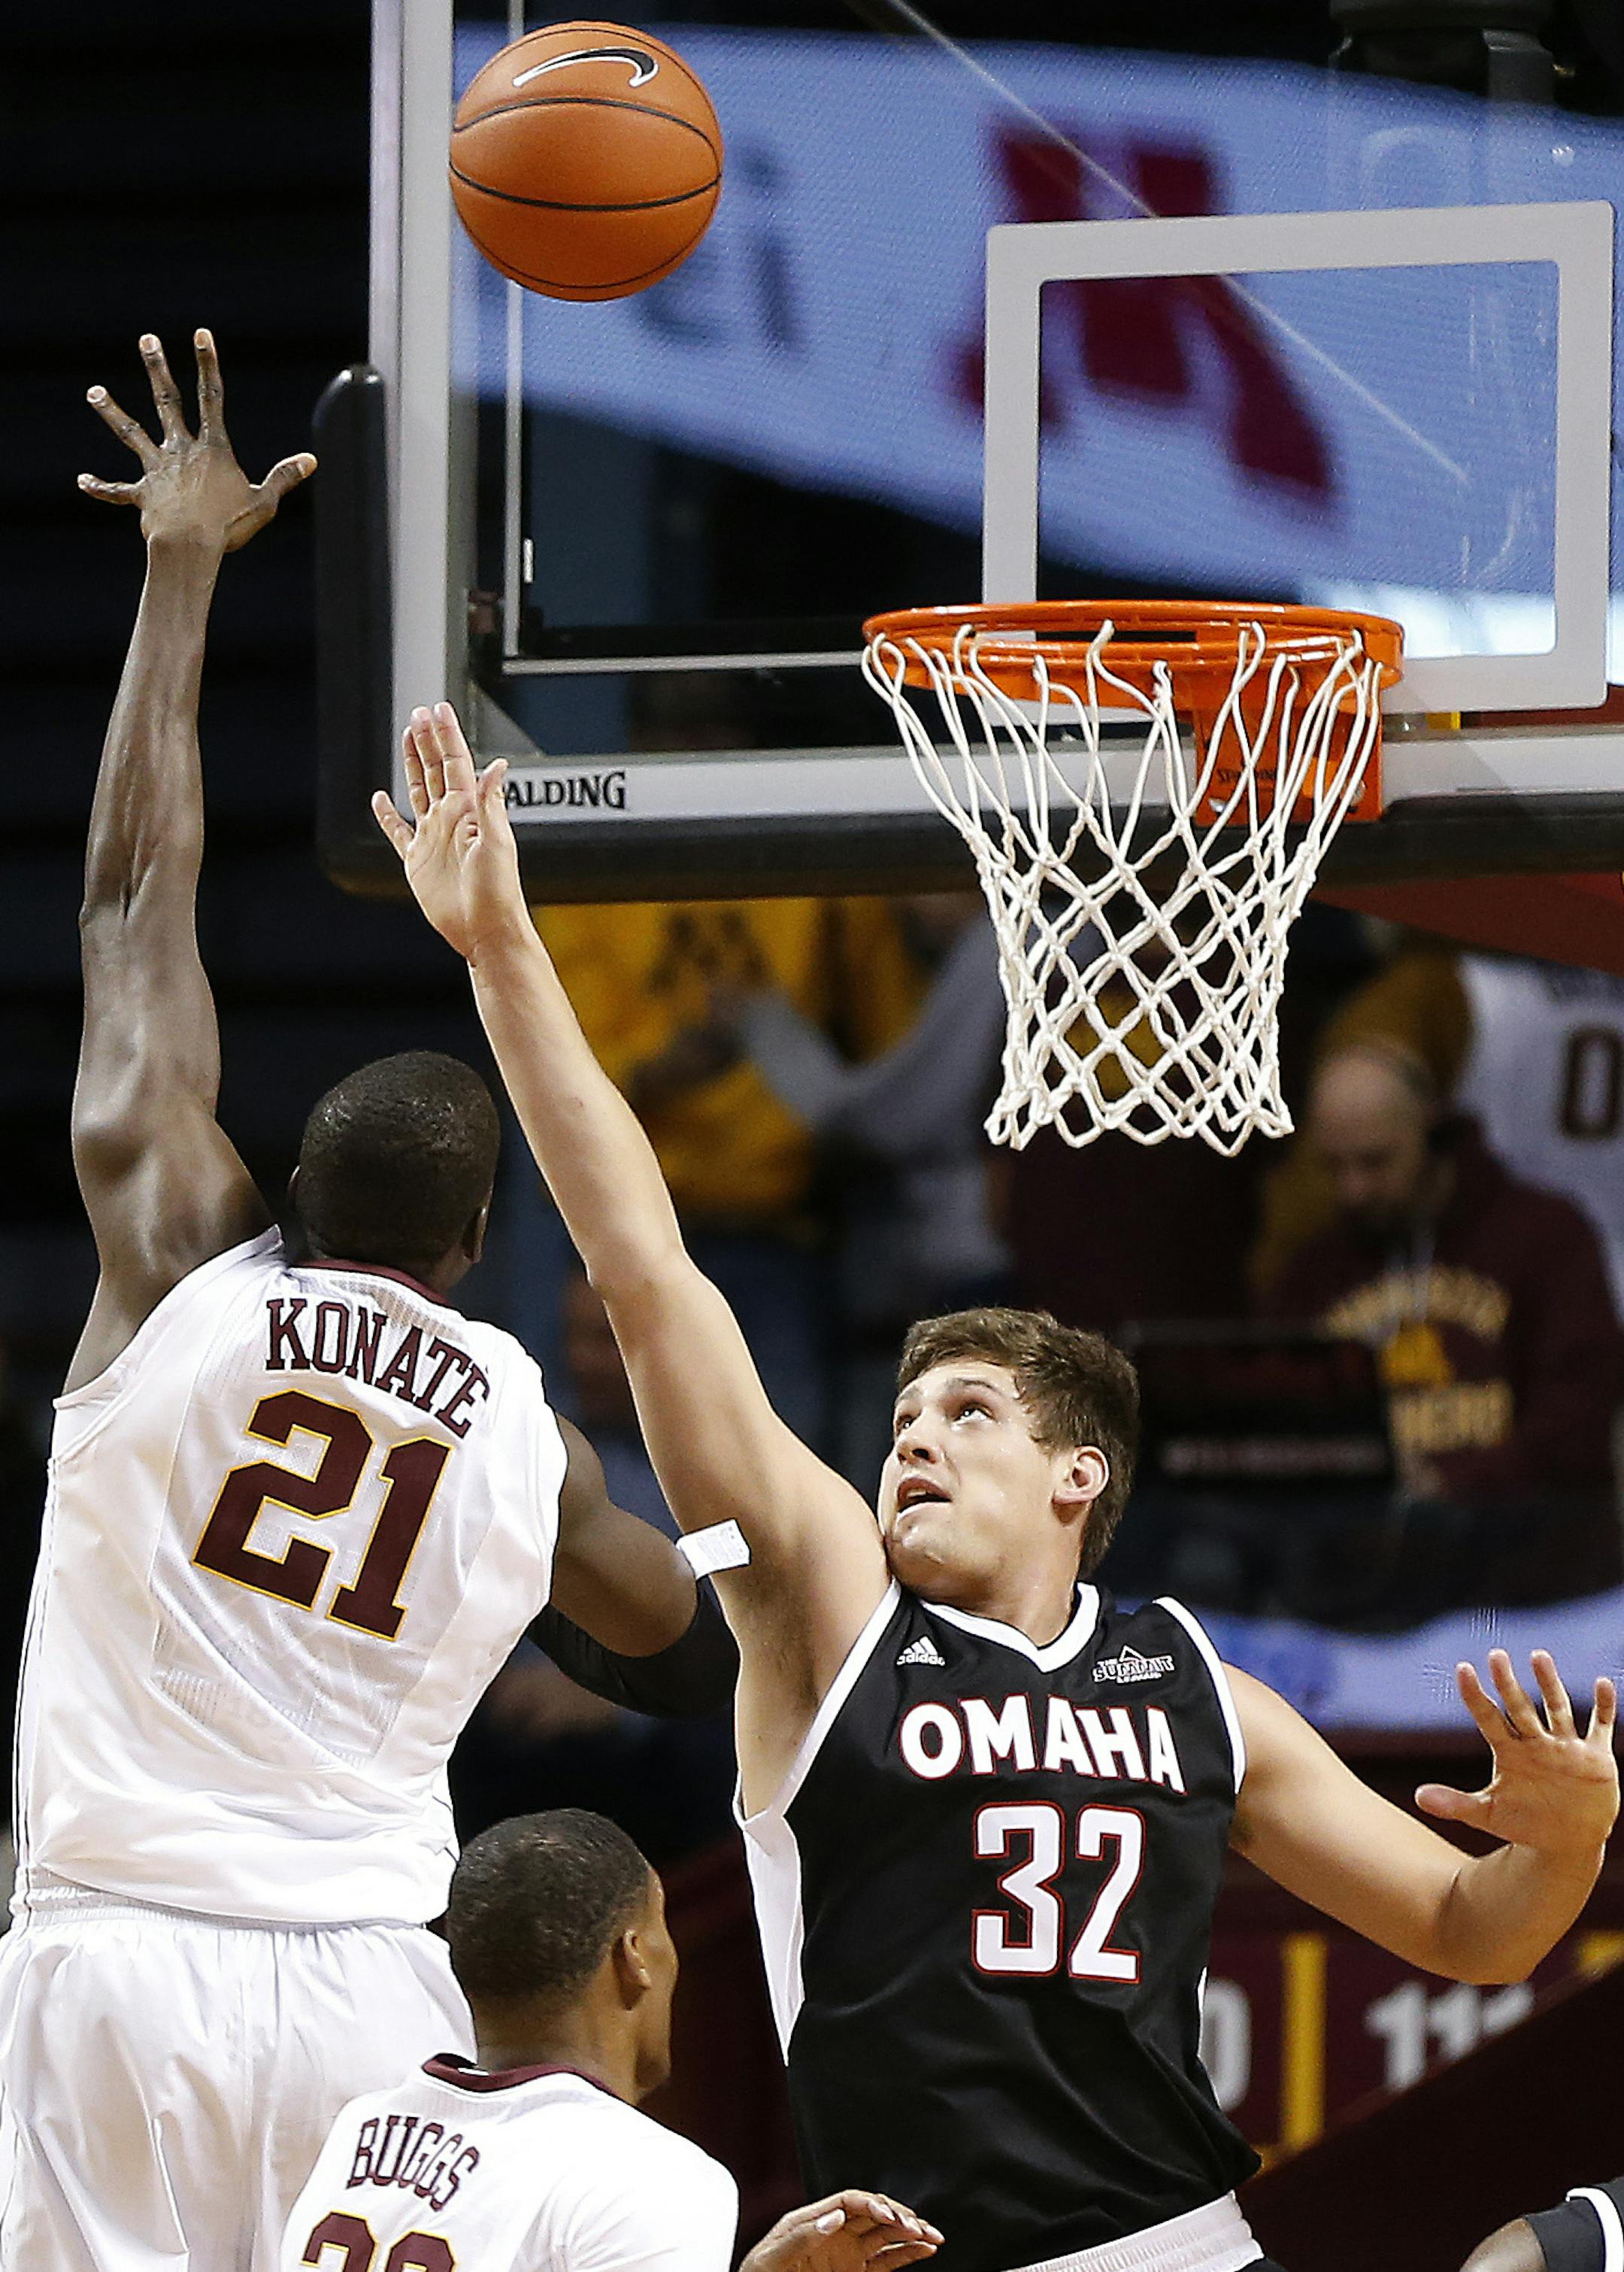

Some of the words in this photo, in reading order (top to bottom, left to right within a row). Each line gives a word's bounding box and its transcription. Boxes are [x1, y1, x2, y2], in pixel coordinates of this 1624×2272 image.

[504, 769, 626, 810] ALDING
[265, 1298, 489, 1439] KONATE
[191, 1388, 455, 1642] 21
[896, 1651, 945, 1667] adidas
[899, 1693, 1188, 1795] OMAHA
[971, 1800, 1146, 1984] 32
[346, 2115, 480, 2211] BUGGS
